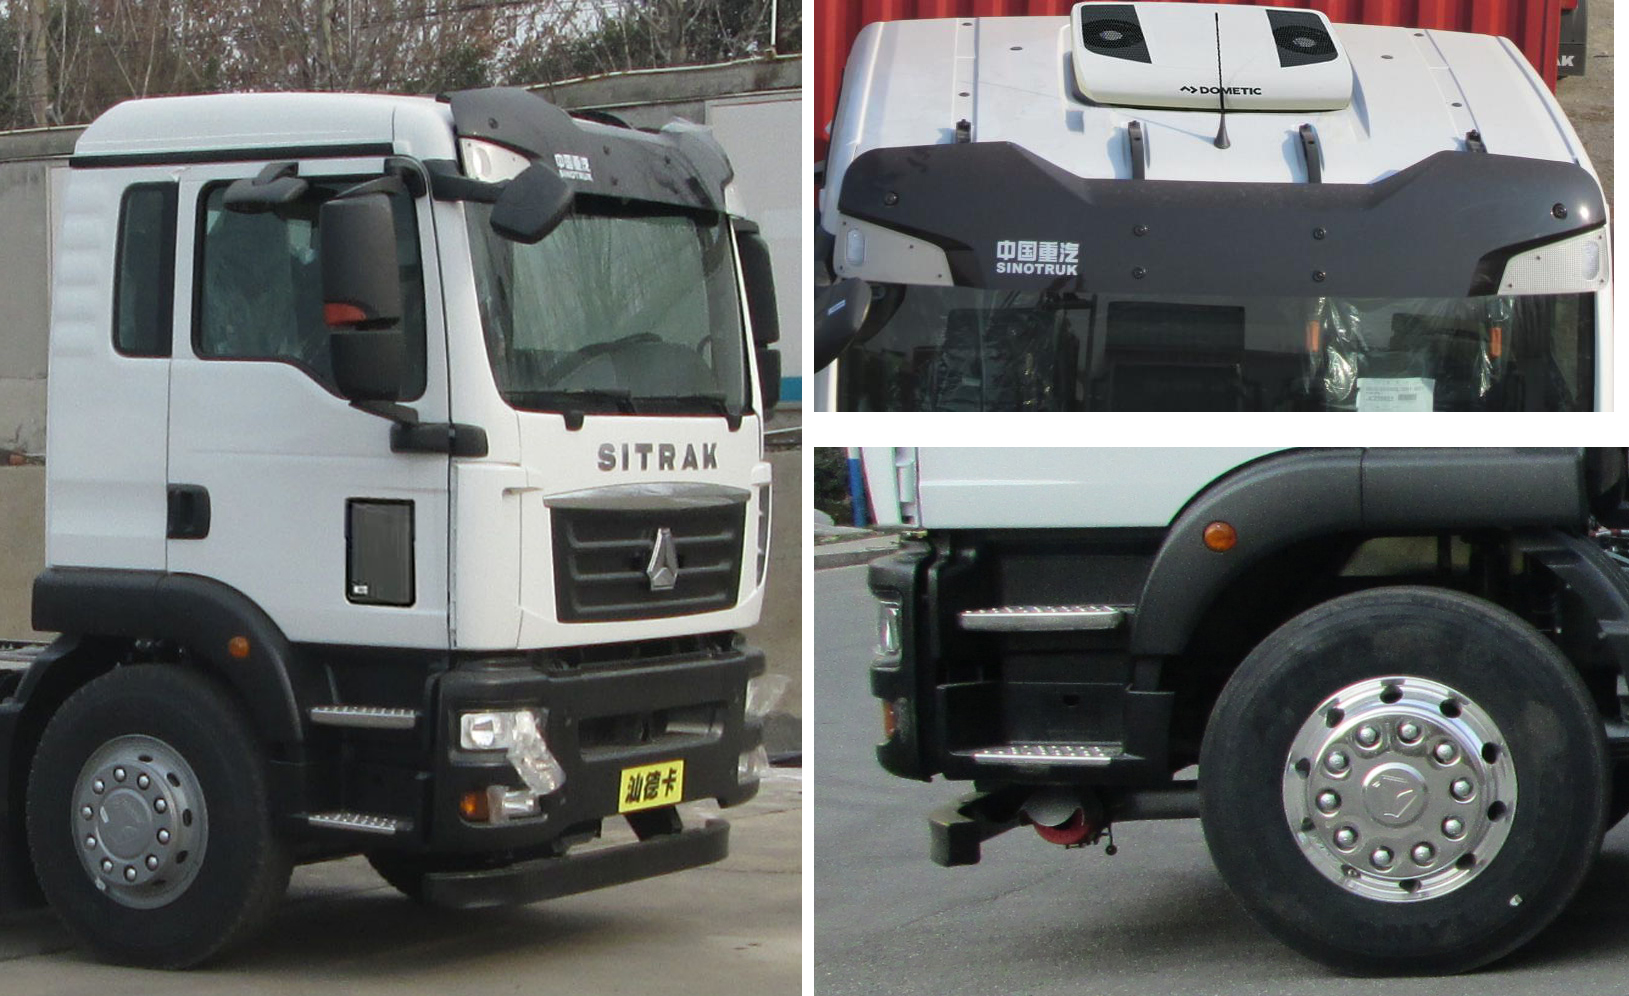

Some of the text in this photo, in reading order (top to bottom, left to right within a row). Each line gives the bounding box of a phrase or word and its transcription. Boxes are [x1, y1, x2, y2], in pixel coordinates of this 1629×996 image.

[1557, 55, 1574, 66] K
[1200, 86, 1262, 95] DOMETIC
[996, 240, 1079, 263] 中国重汽
[996, 262, 1078, 276] SINOTRUK
[597, 442, 717, 471] SITRAK
[625, 767, 677, 803] 汕德卡
